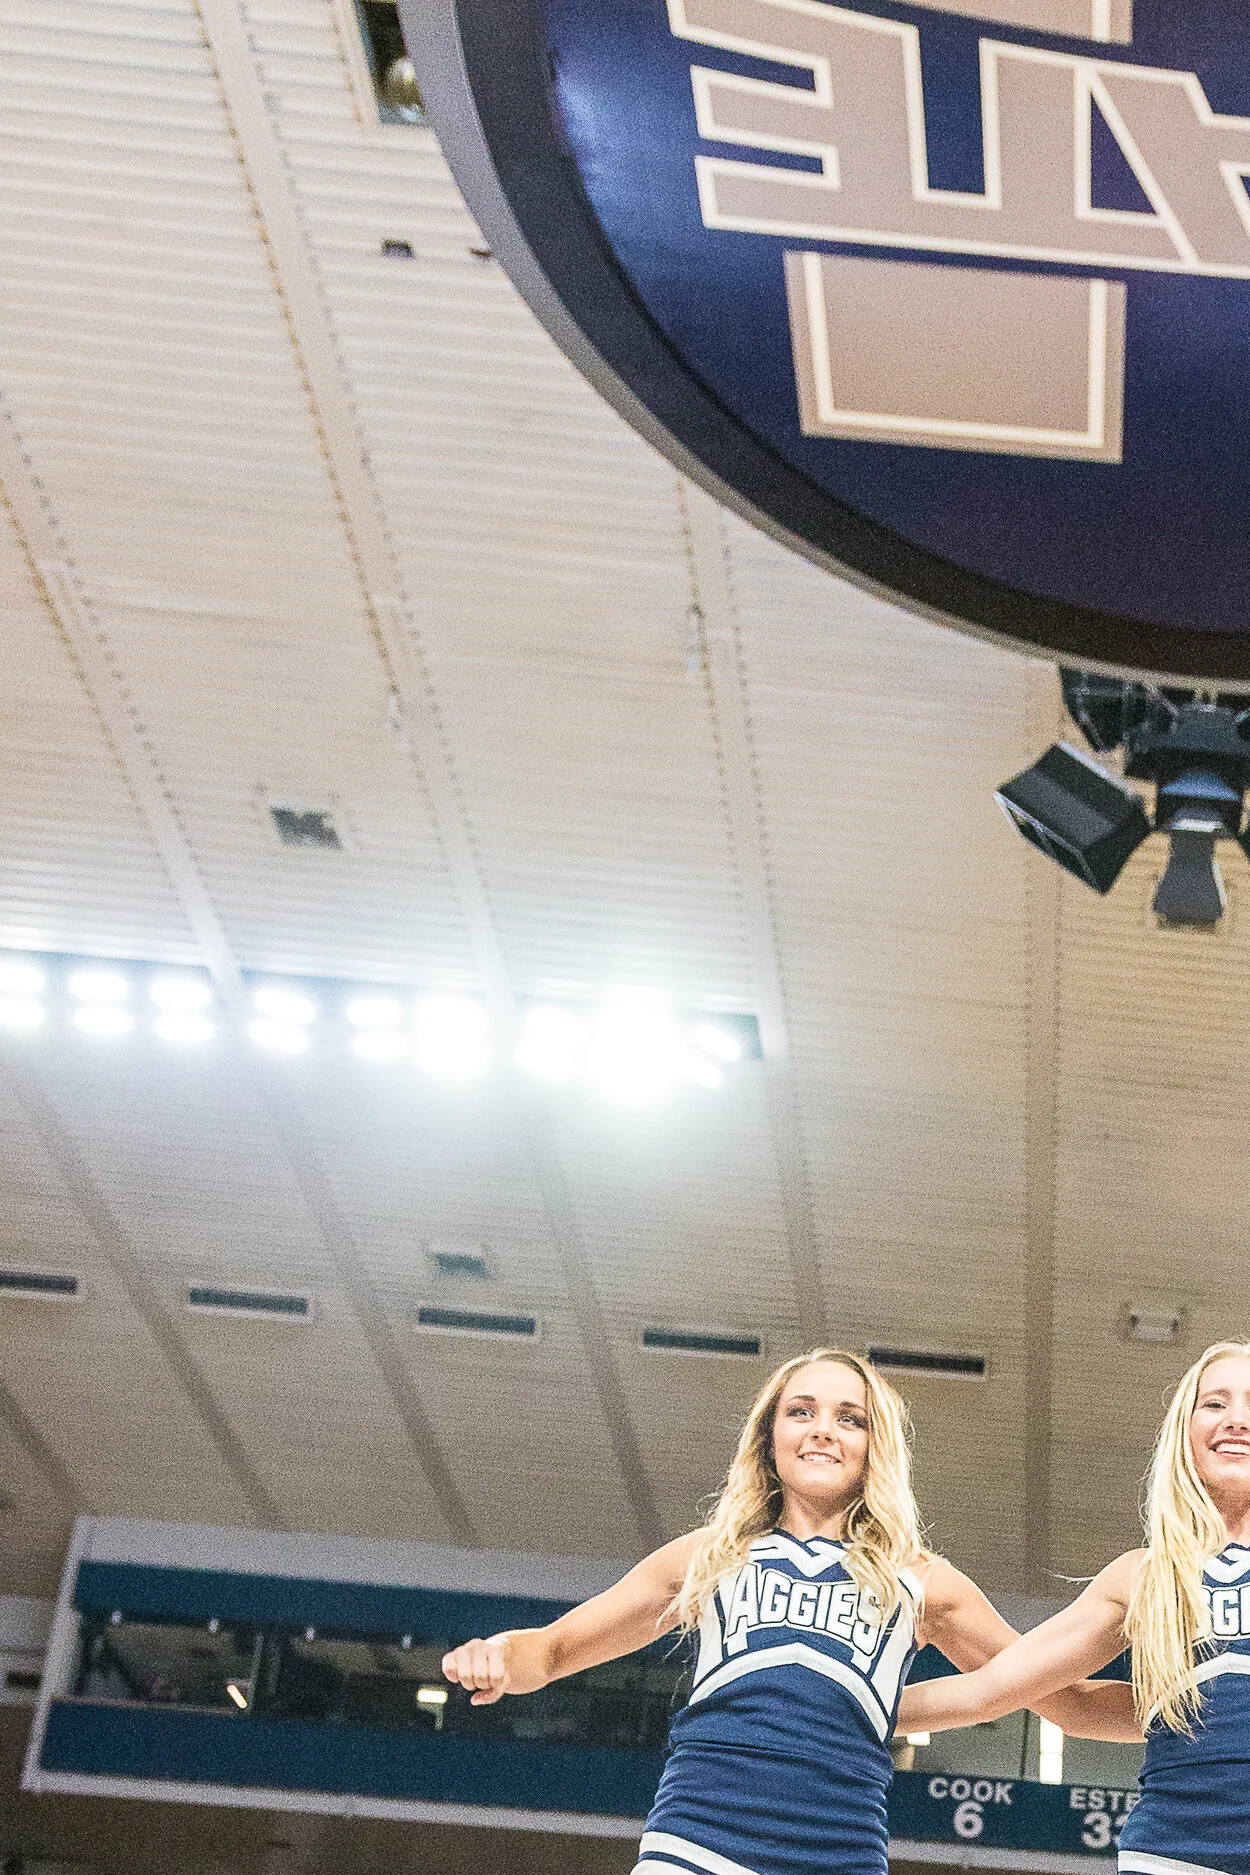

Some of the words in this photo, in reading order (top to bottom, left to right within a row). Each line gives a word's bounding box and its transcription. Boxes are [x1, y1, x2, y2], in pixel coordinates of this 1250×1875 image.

[723, 1562, 883, 1657] AGGIES
[928, 1775, 1013, 1808] COOK
[1069, 1787, 1141, 1813] ESTE
[952, 1803, 985, 1840] 6
[1081, 1811, 1128, 1849] 3
